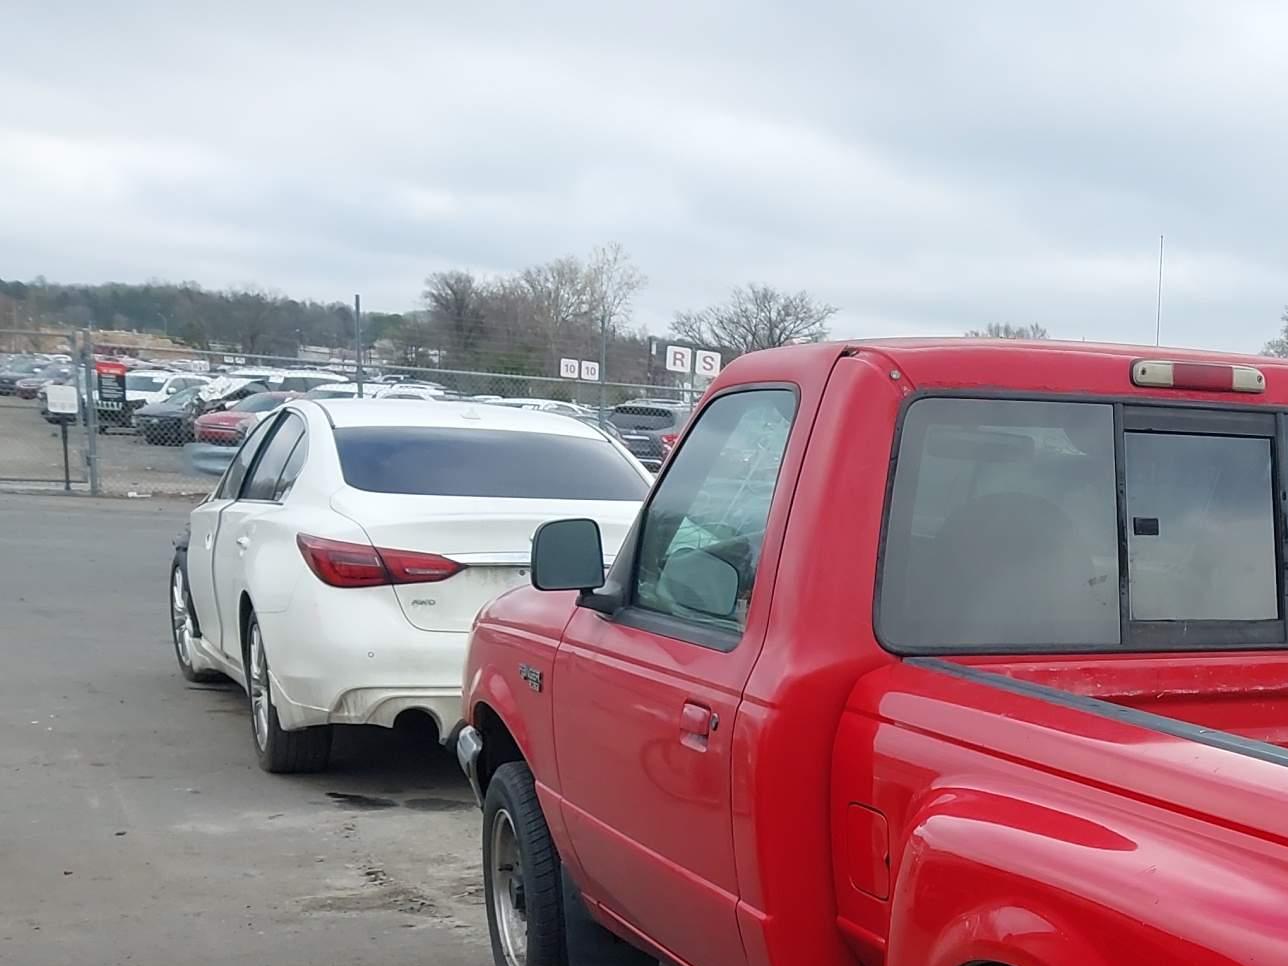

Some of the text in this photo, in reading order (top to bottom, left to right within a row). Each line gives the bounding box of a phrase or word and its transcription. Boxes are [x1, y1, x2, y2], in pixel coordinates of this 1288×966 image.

[672, 351, 685, 368] R
[702, 355, 715, 372] S
[565, 364, 576, 374] 10
[585, 366, 597, 376] 10
